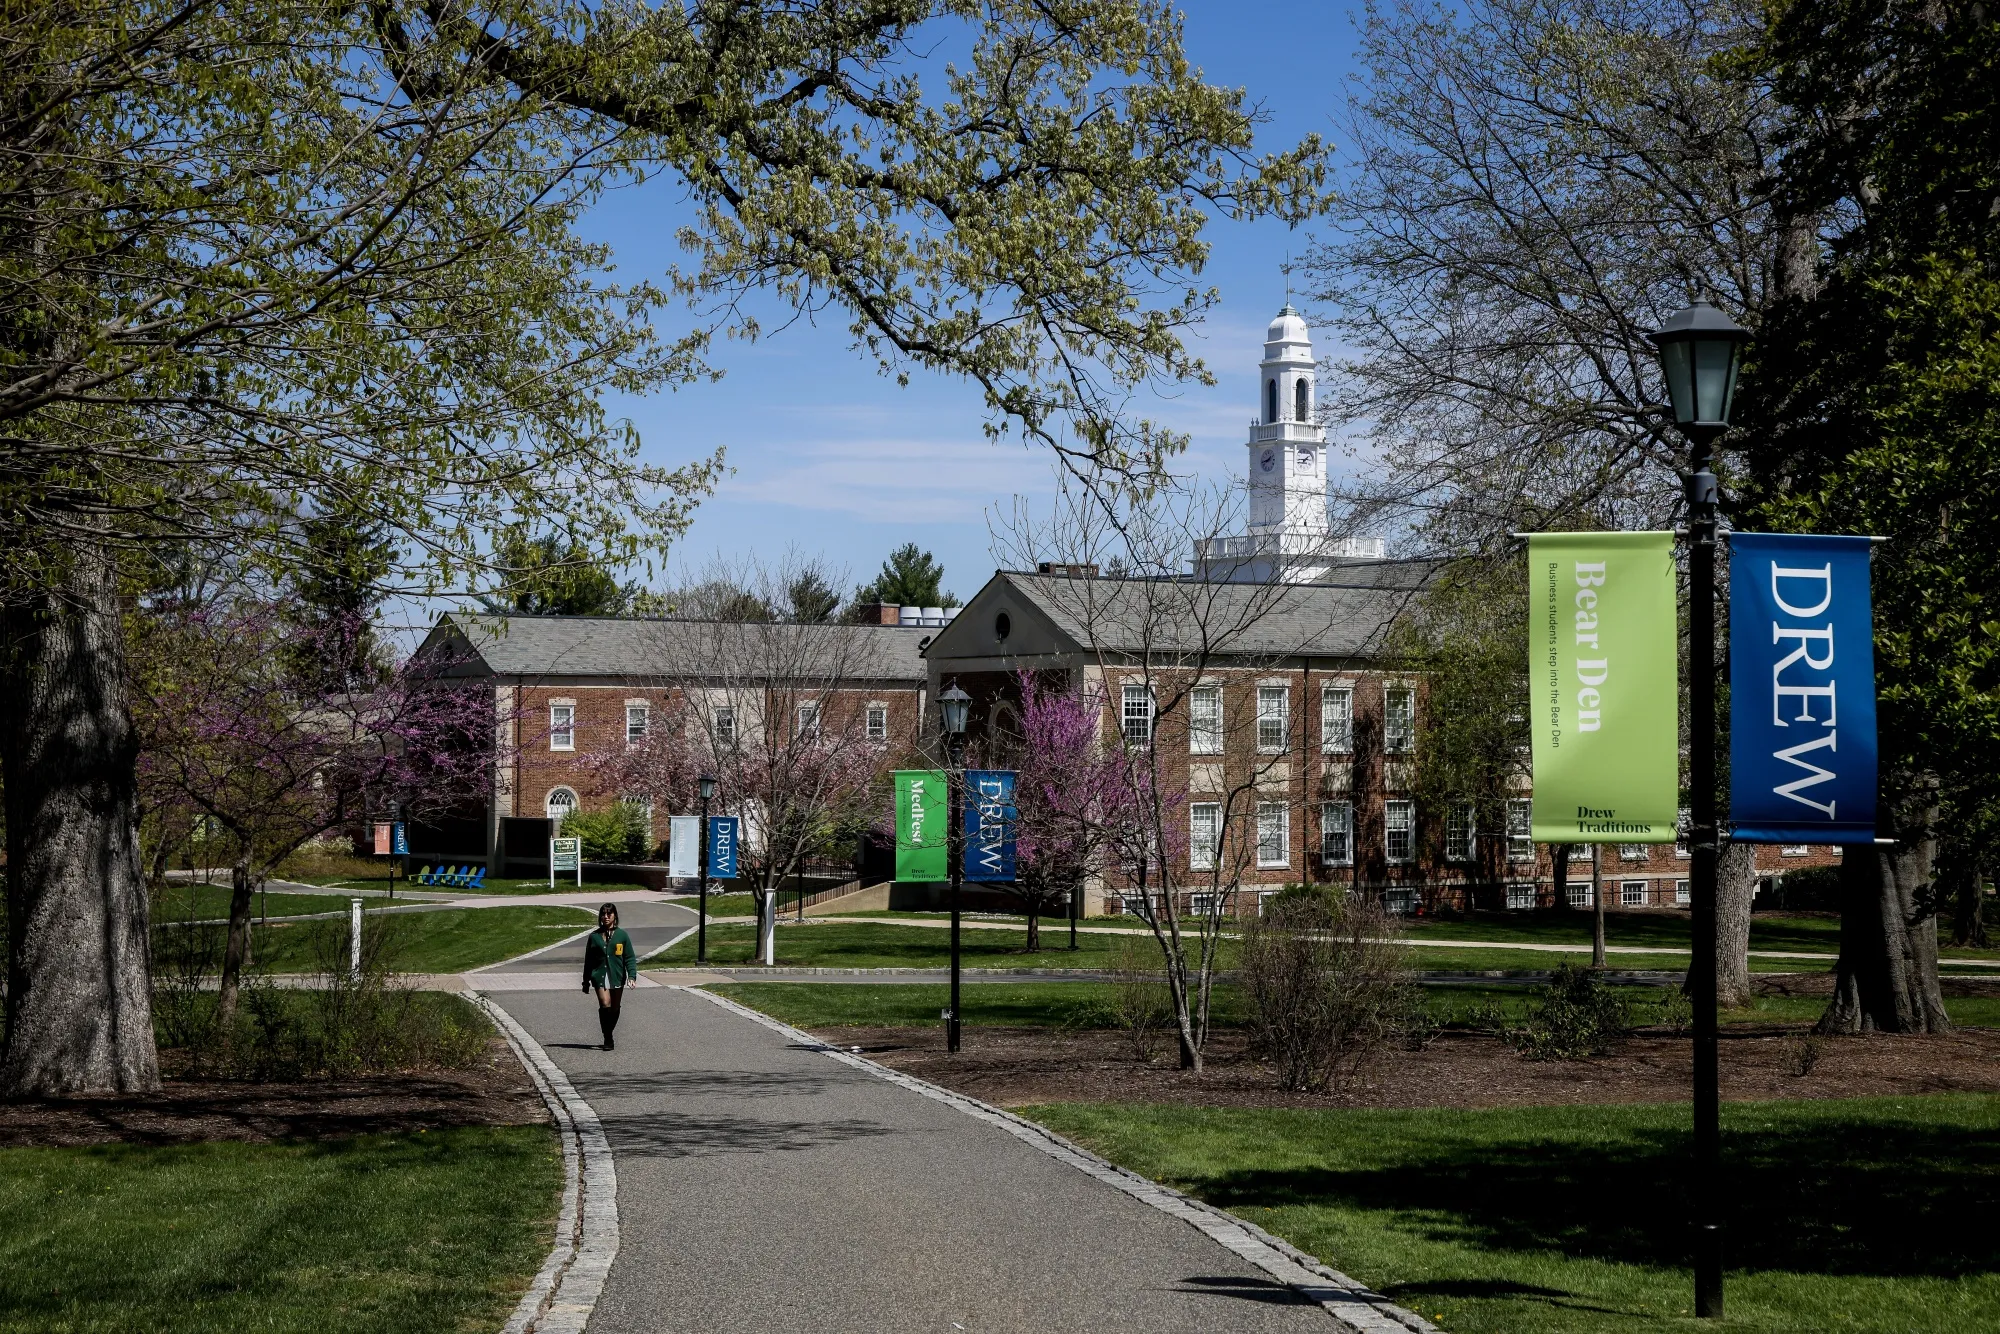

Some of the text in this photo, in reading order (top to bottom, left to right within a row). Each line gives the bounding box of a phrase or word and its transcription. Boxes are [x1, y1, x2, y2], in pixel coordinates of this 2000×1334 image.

[1548, 562, 1561, 748] Business students step into the Bear Den
[1575, 560, 1608, 734] Bear Den
[1771, 560, 1837, 820] DREW
[717, 822, 730, 873] DREW
[911, 780, 924, 843] MedFest
[979, 780, 1002, 872] DREW
[1576, 806, 1616, 819] Drew
[1576, 820, 1652, 834] Traditions
